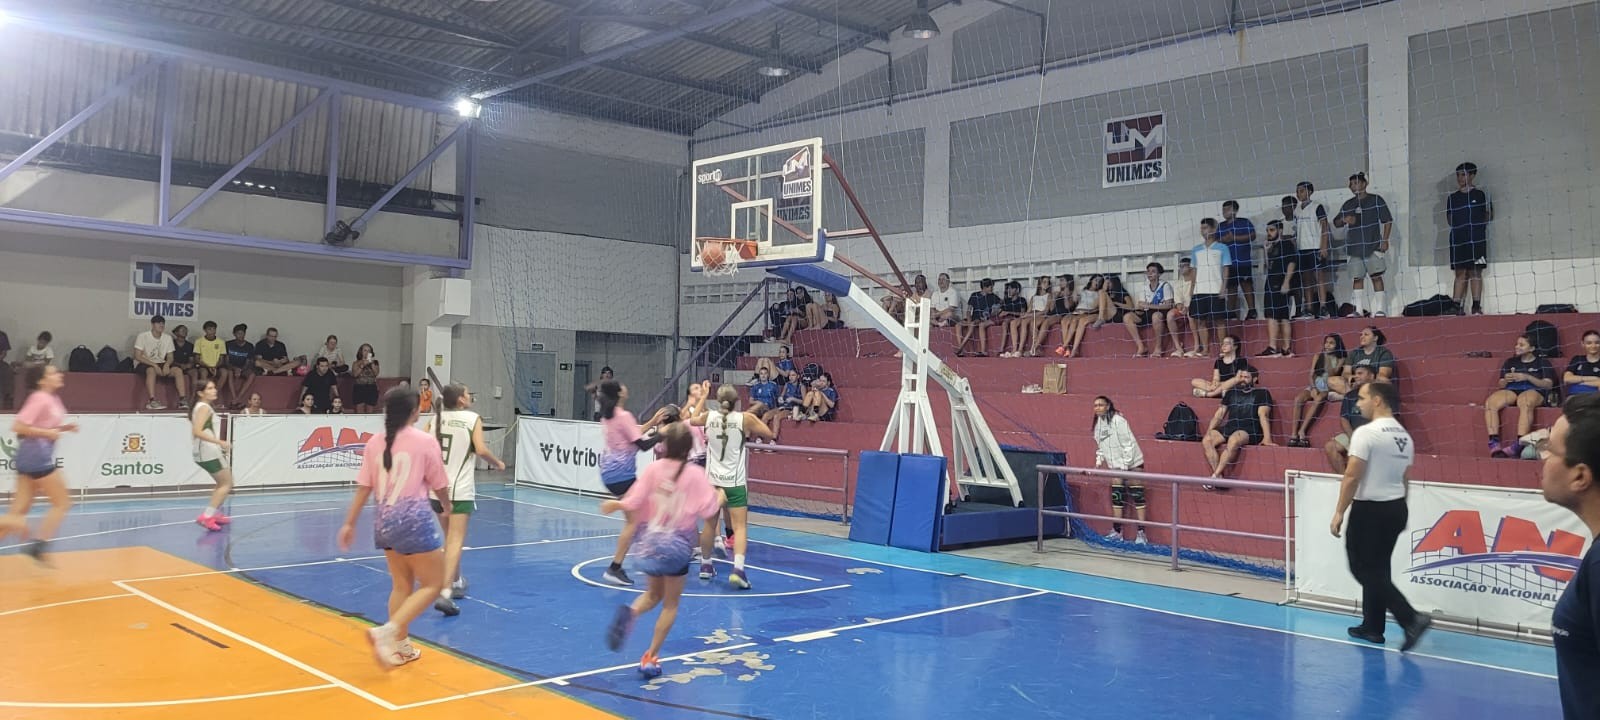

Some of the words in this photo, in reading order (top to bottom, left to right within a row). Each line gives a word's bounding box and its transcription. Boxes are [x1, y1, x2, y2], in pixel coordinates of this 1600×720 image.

[1106, 161, 1162, 183] UNIMES
[784, 181, 811, 195] UNIMES
[777, 206, 810, 221] UNIMES
[134, 301, 194, 317] UNIMES
[556, 445, 570, 465] tv
[716, 434, 729, 461] 7
[101, 461, 164, 476] Santos
[1491, 586, 1558, 601] NACIONAL
